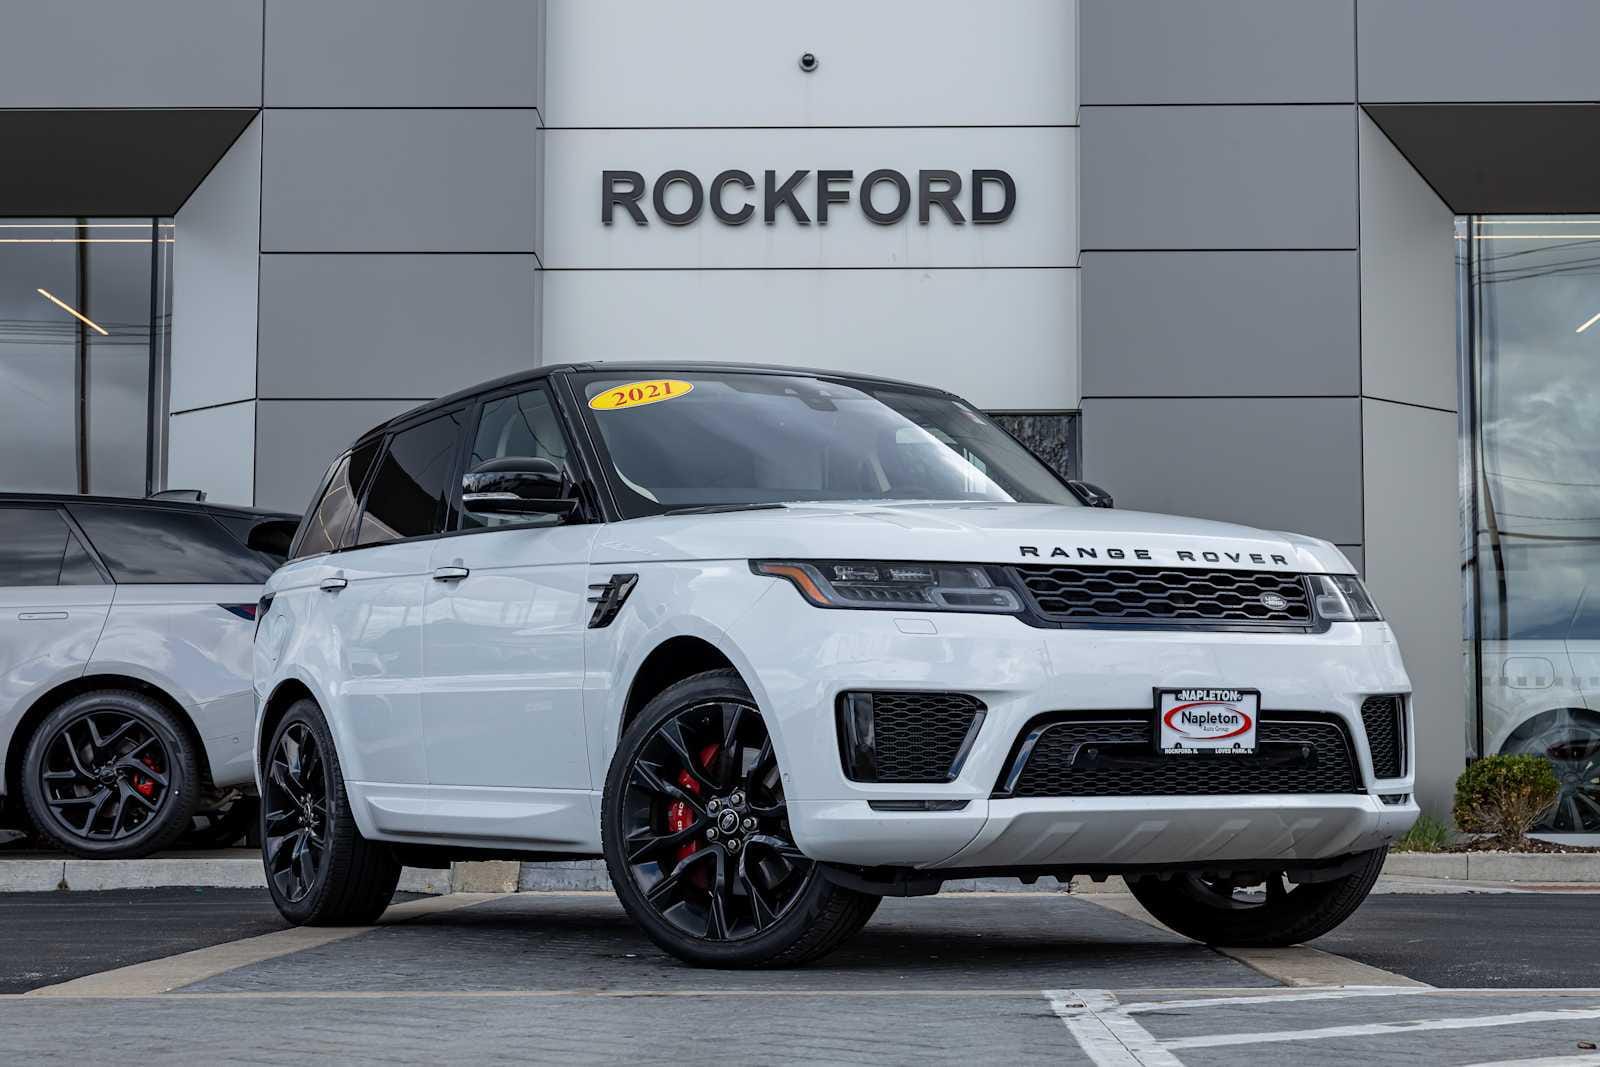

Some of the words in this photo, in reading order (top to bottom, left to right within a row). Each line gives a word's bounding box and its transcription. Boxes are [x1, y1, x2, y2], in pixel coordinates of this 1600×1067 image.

[601, 169, 1016, 226] ROCKFORD
[612, 382, 673, 406] 2021
[1019, 546, 1152, 560] RANGE
[1176, 550, 1288, 565] ROVER
[1182, 690, 1238, 701] NAPLETON
[1182, 711, 1238, 726] Napleton
